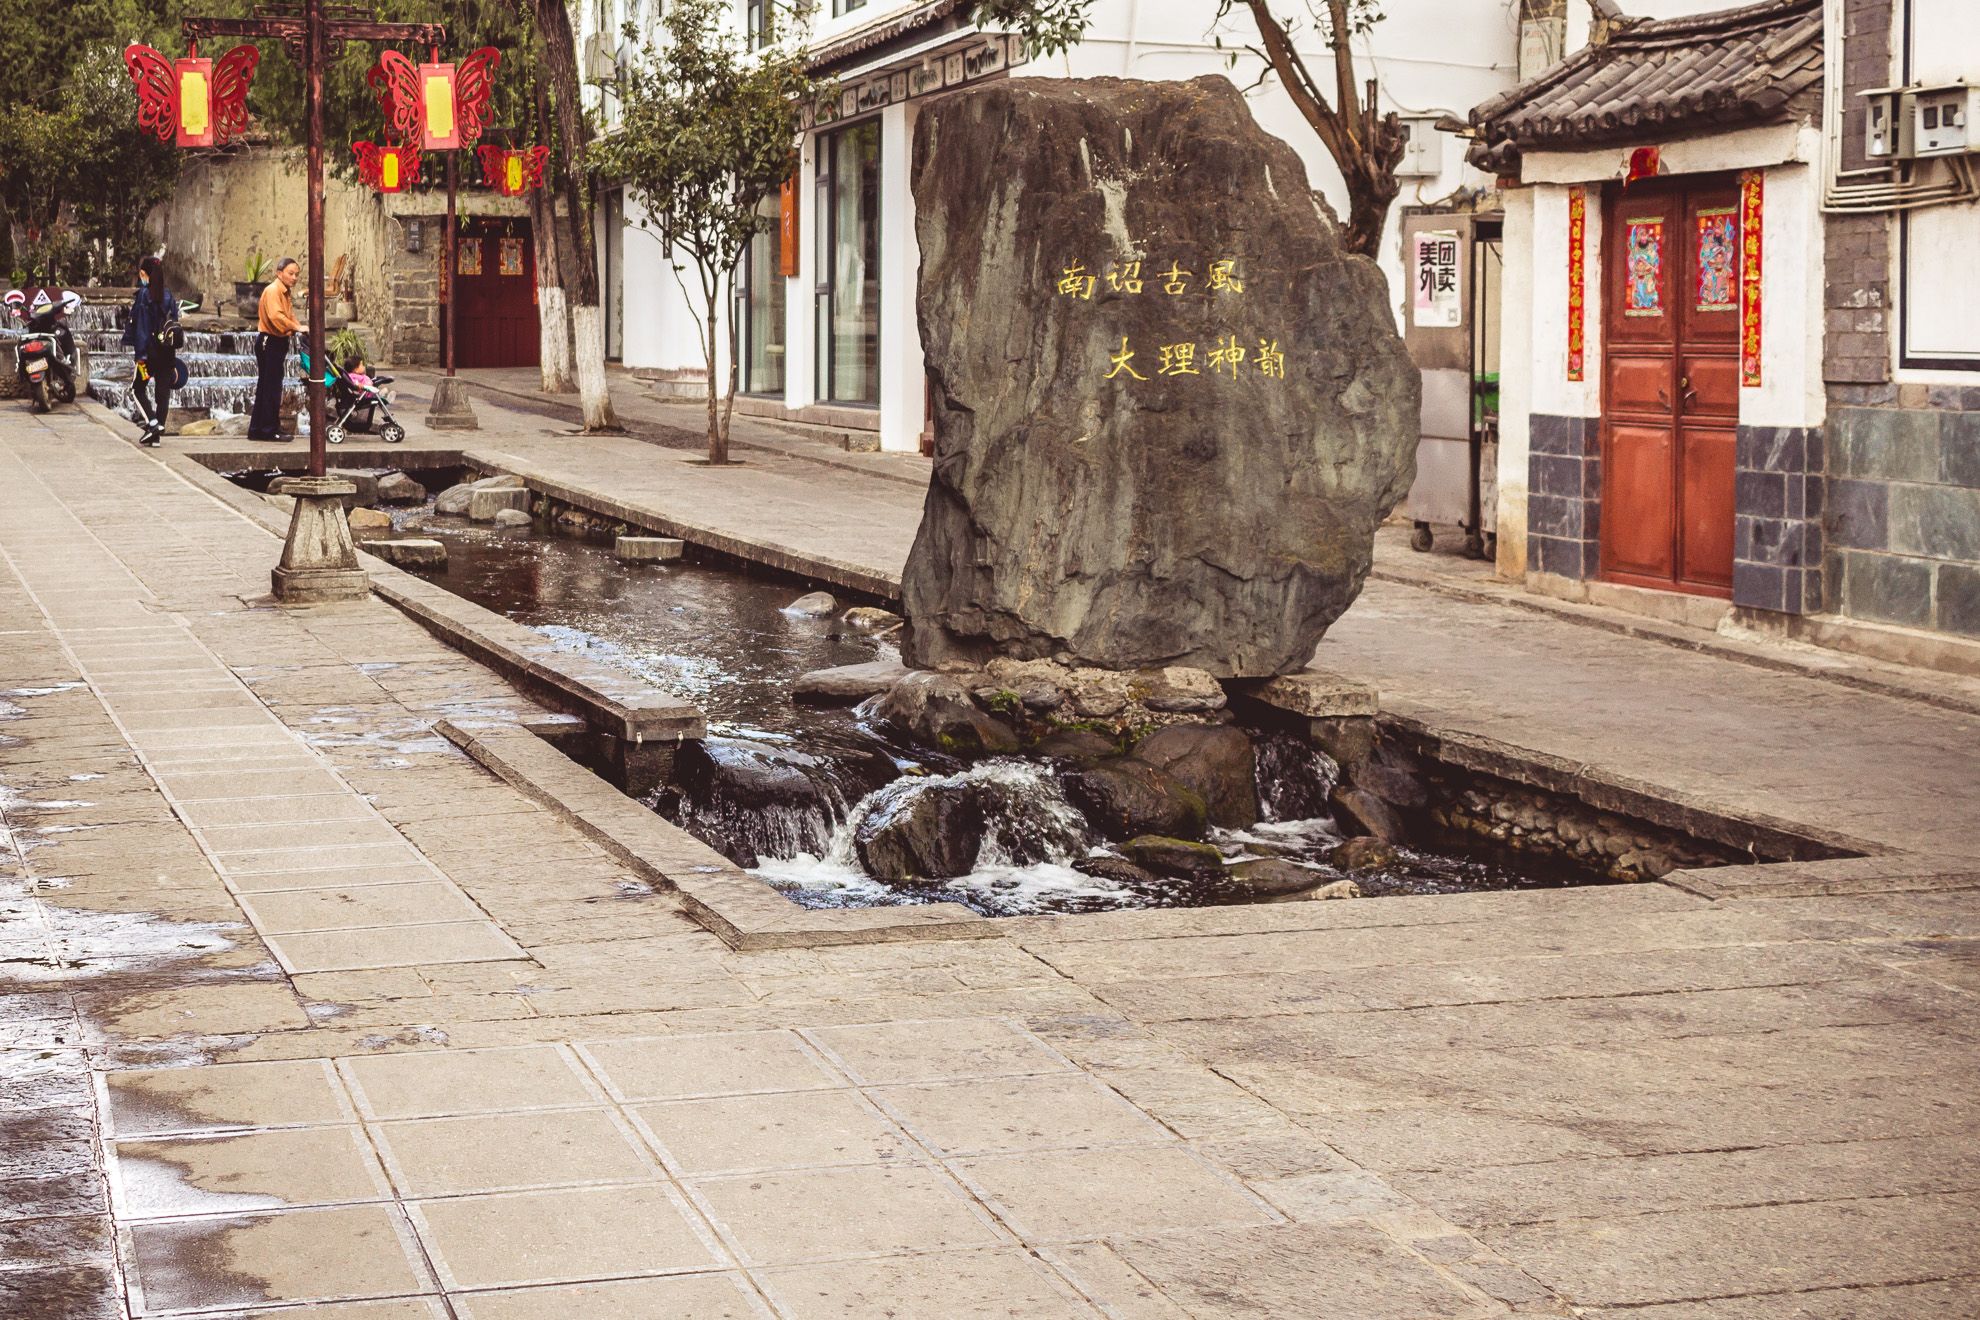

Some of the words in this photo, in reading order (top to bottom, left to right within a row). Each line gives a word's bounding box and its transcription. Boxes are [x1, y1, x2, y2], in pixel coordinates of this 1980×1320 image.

[1420, 241, 1455, 266] 美团
[1420, 267, 1455, 302] 外卖
[1103, 335, 1285, 381] 大理神韵
